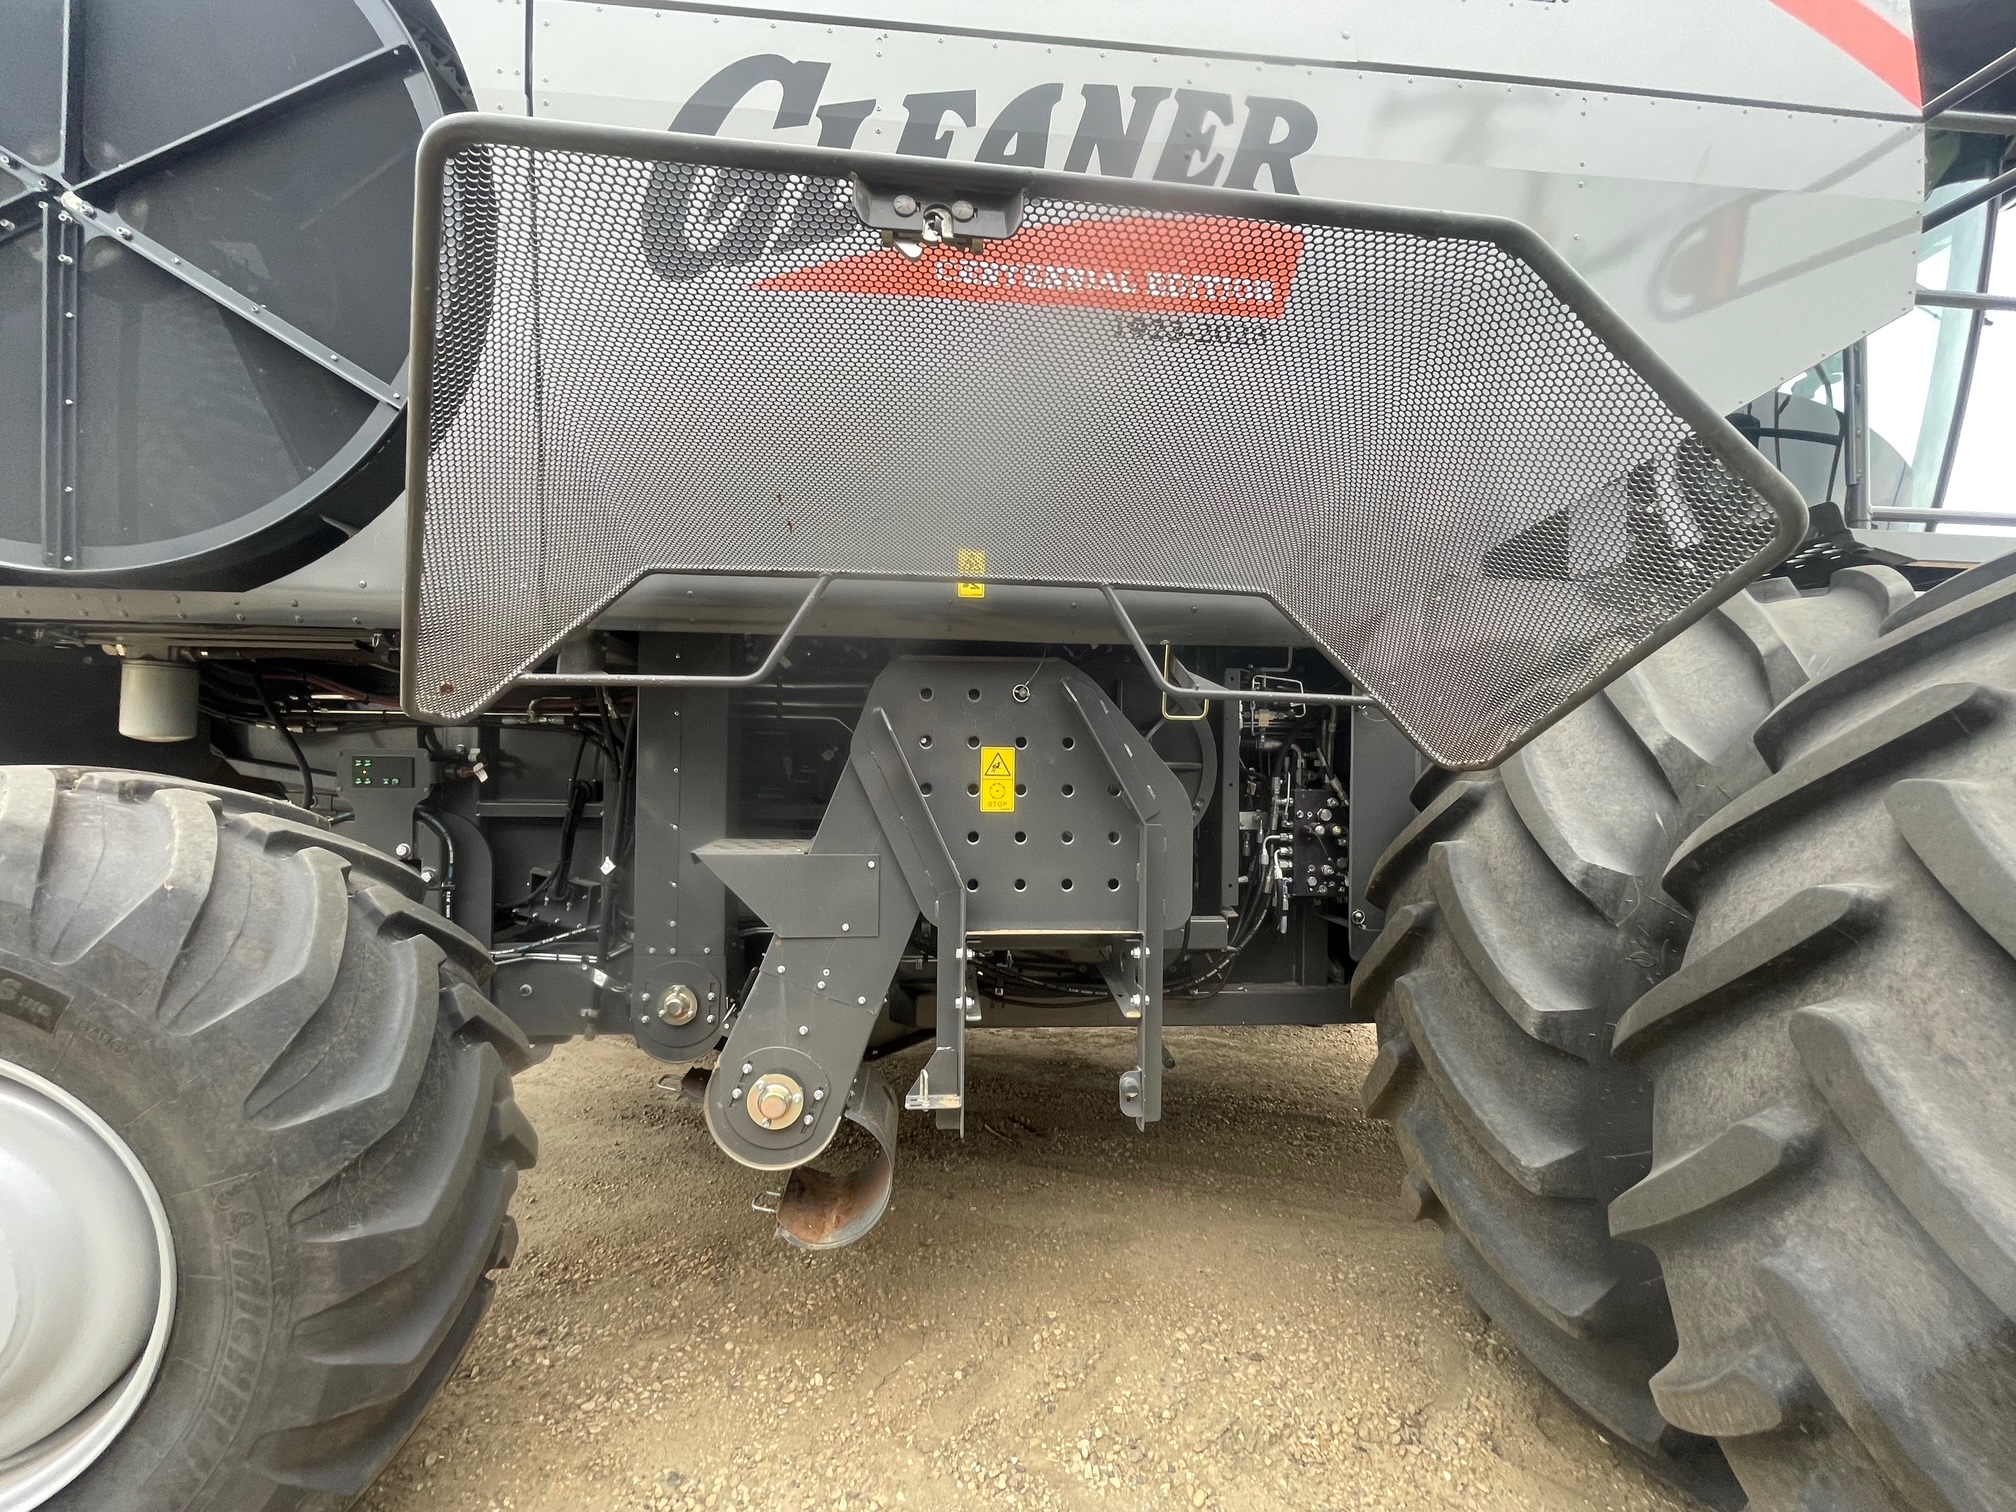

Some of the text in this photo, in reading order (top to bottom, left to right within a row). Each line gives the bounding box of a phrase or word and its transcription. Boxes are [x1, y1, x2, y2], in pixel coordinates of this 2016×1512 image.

[641, 53, 1318, 283] GLEANER
[936, 260, 1276, 301] CENTENNIAL EDITION
